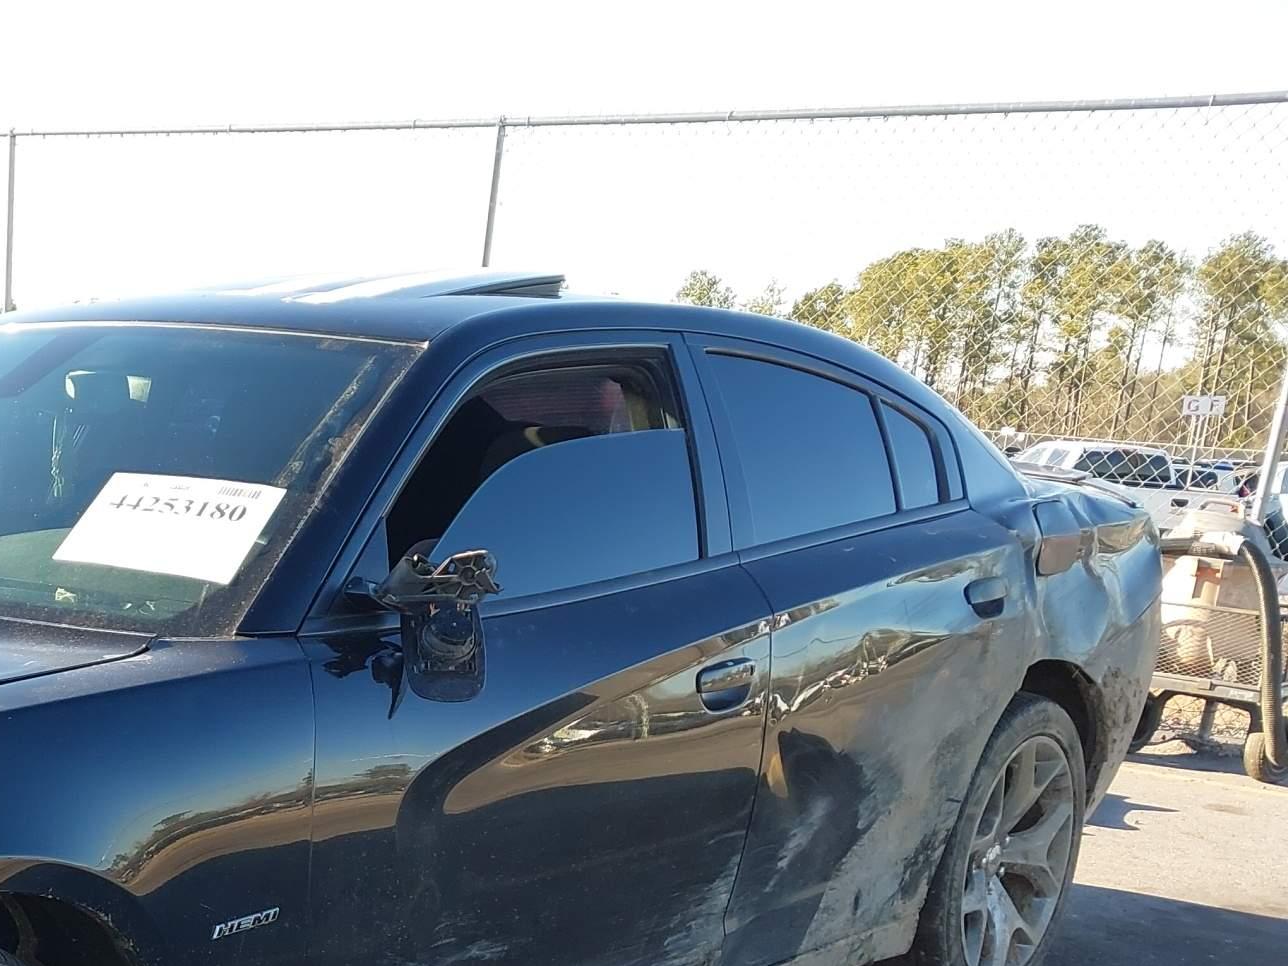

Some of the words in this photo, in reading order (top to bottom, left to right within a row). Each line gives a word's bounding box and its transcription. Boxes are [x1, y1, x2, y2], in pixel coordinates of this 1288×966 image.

[1187, 399, 1200, 413] G
[110, 494, 248, 523] 44253180
[212, 906, 280, 941] HEMI
